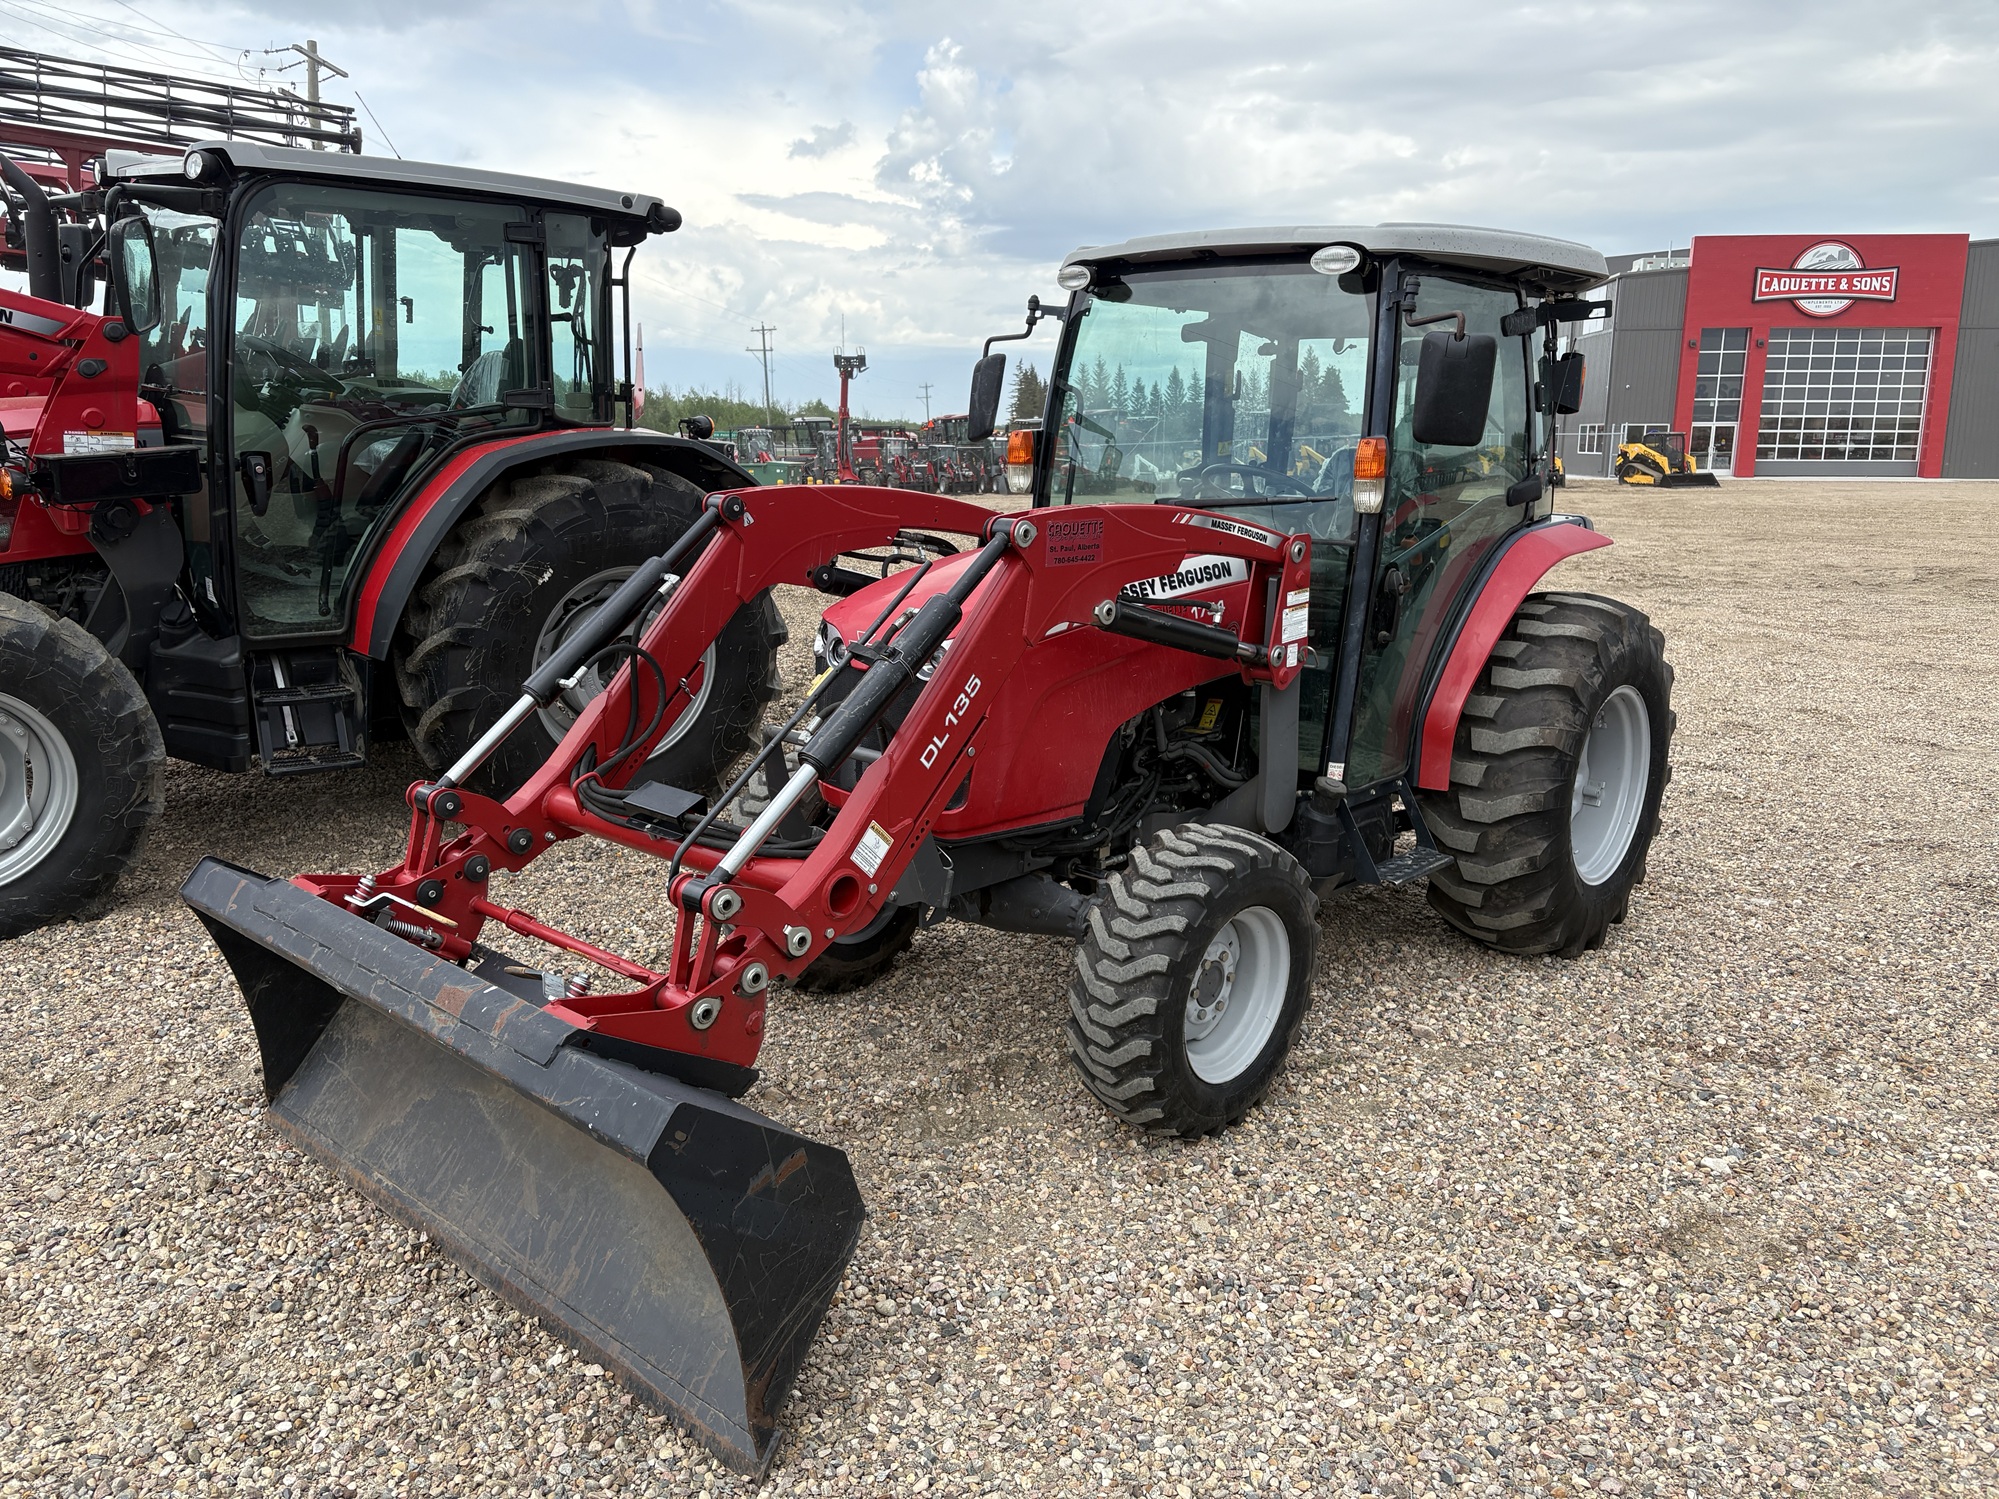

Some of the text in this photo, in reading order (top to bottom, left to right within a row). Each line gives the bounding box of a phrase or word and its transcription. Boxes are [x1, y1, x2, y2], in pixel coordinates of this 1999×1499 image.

[1761, 277, 1891, 292] CAOUETTE & SONS
[1210, 519, 1269, 544] MASSEY FERGUSON
[1050, 543, 1100, 553] St. Paul, Alberta
[1053, 554, 1096, 565] 780-645-4422
[1120, 561, 1233, 599] SSEY FERGUSON
